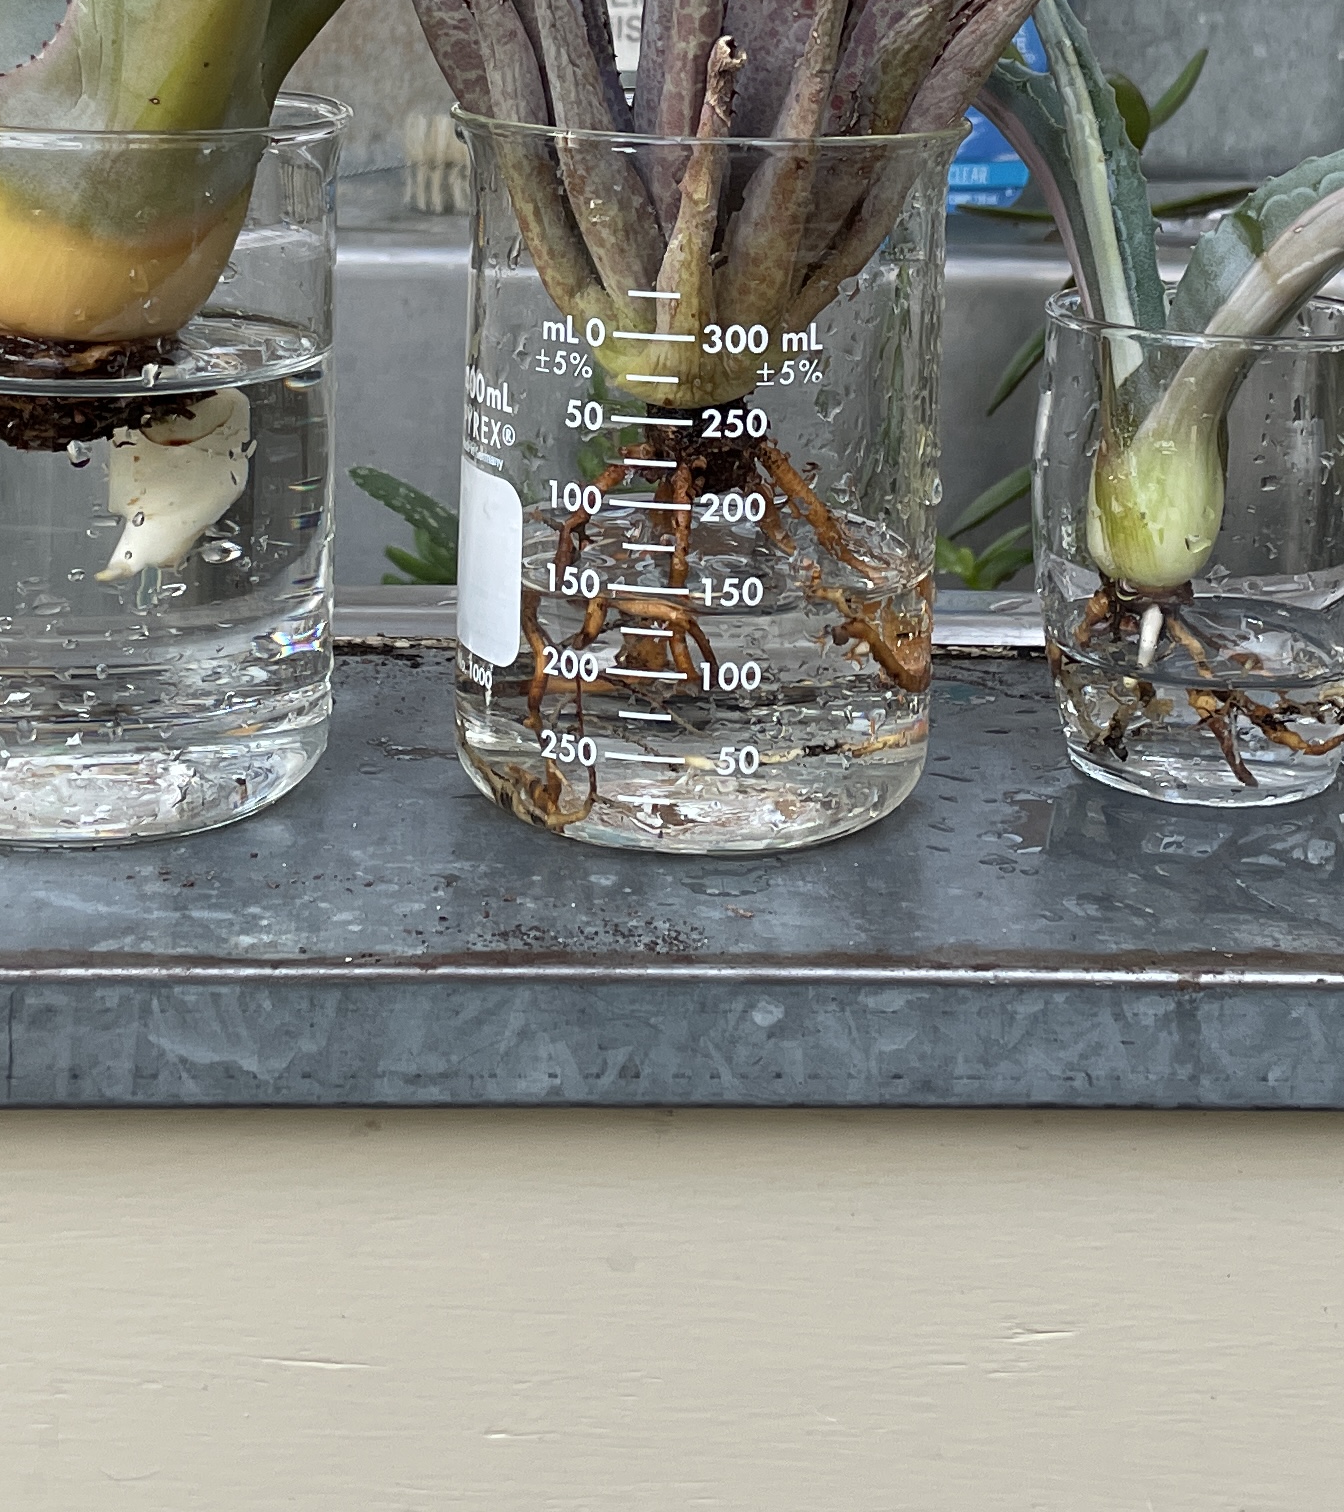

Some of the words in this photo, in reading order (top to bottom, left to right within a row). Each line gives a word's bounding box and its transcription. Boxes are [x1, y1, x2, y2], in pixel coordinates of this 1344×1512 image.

[543, 316, 580, 344] mL
[585, 316, 606, 347] 0
[702, 324, 770, 354] 300
[781, 322, 824, 352] mL
[565, 400, 604, 432] 50
[701, 408, 768, 439] 250
[548, 479, 603, 515] 100
[699, 491, 766, 522] 200
[546, 562, 600, 599] 150
[700, 576, 764, 607] 150
[542, 647, 599, 683] 200
[698, 660, 762, 691] 100
[540, 729, 598, 768] 250
[716, 744, 760, 775] 50
